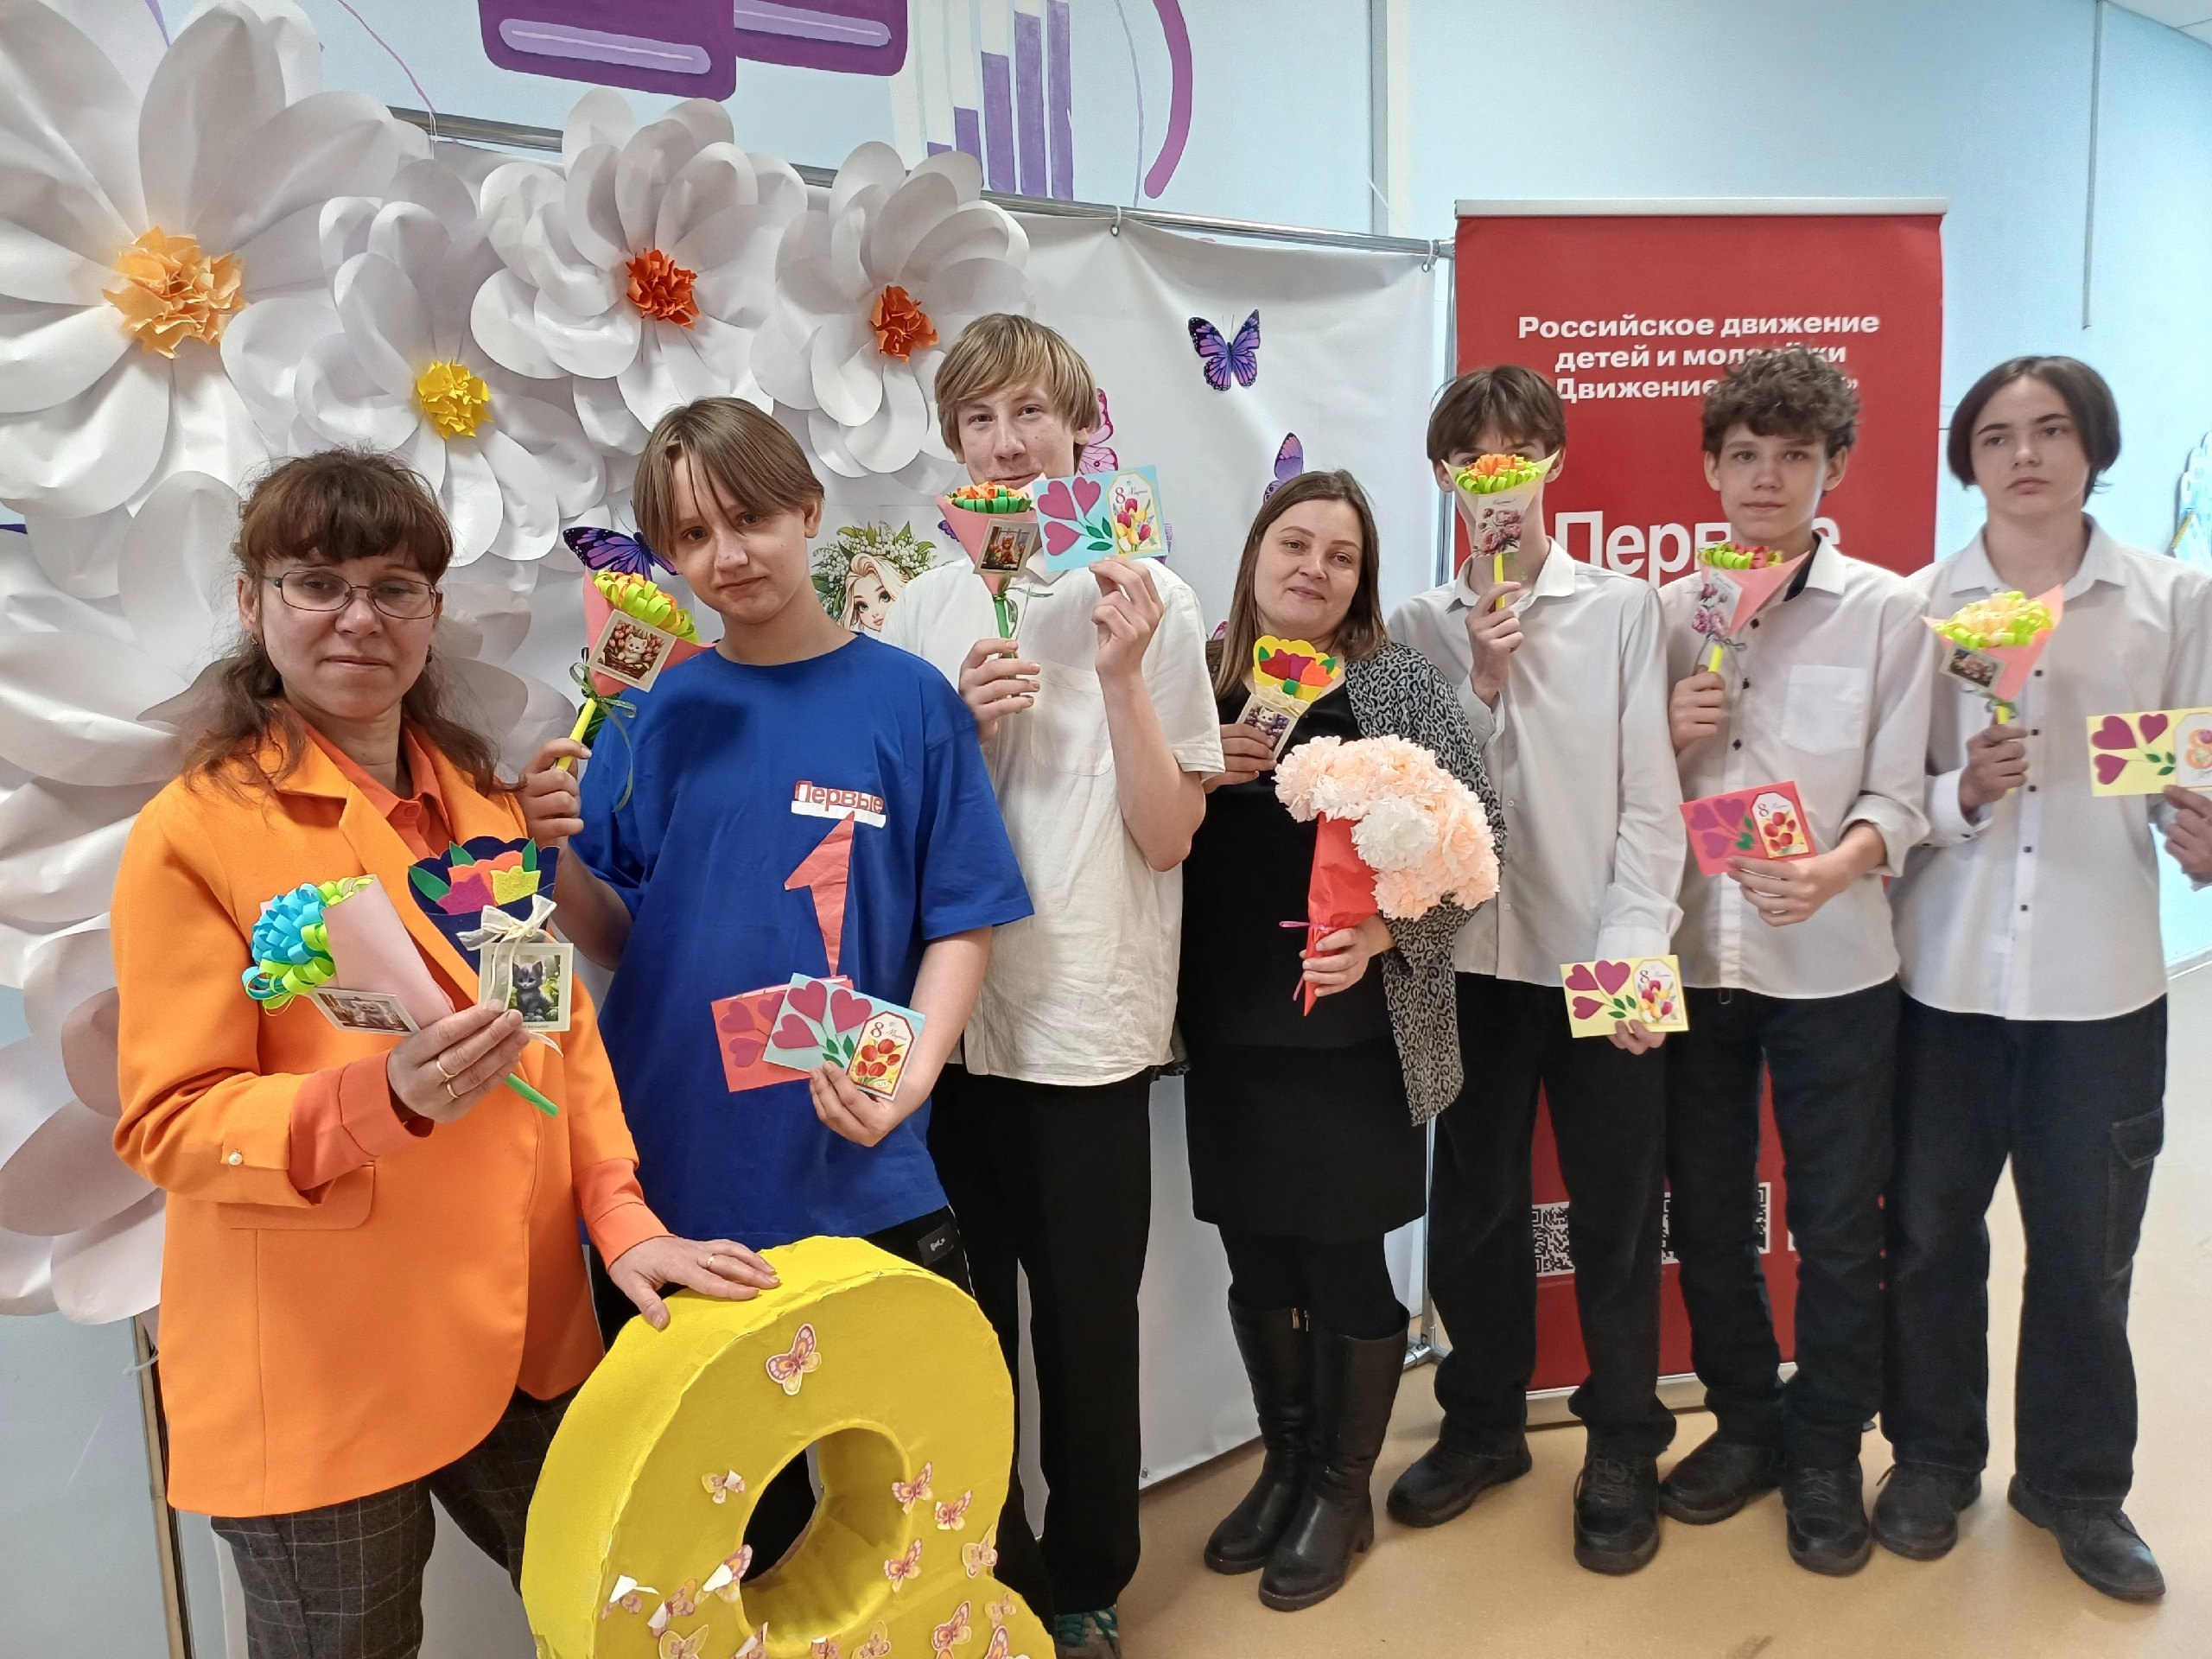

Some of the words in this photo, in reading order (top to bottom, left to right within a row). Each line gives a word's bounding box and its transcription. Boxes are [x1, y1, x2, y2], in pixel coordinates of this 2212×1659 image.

[1518, 314, 1714, 339] Российское
[1720, 315, 1880, 338] движение
[1555, 344, 1649, 372] детей
[1656, 350, 1676, 366] и
[1115, 486, 1126, 504] 8
[794, 779, 885, 814] Первые
[1639, 969, 1650, 984] 8
[870, 1021, 885, 1038] 8
